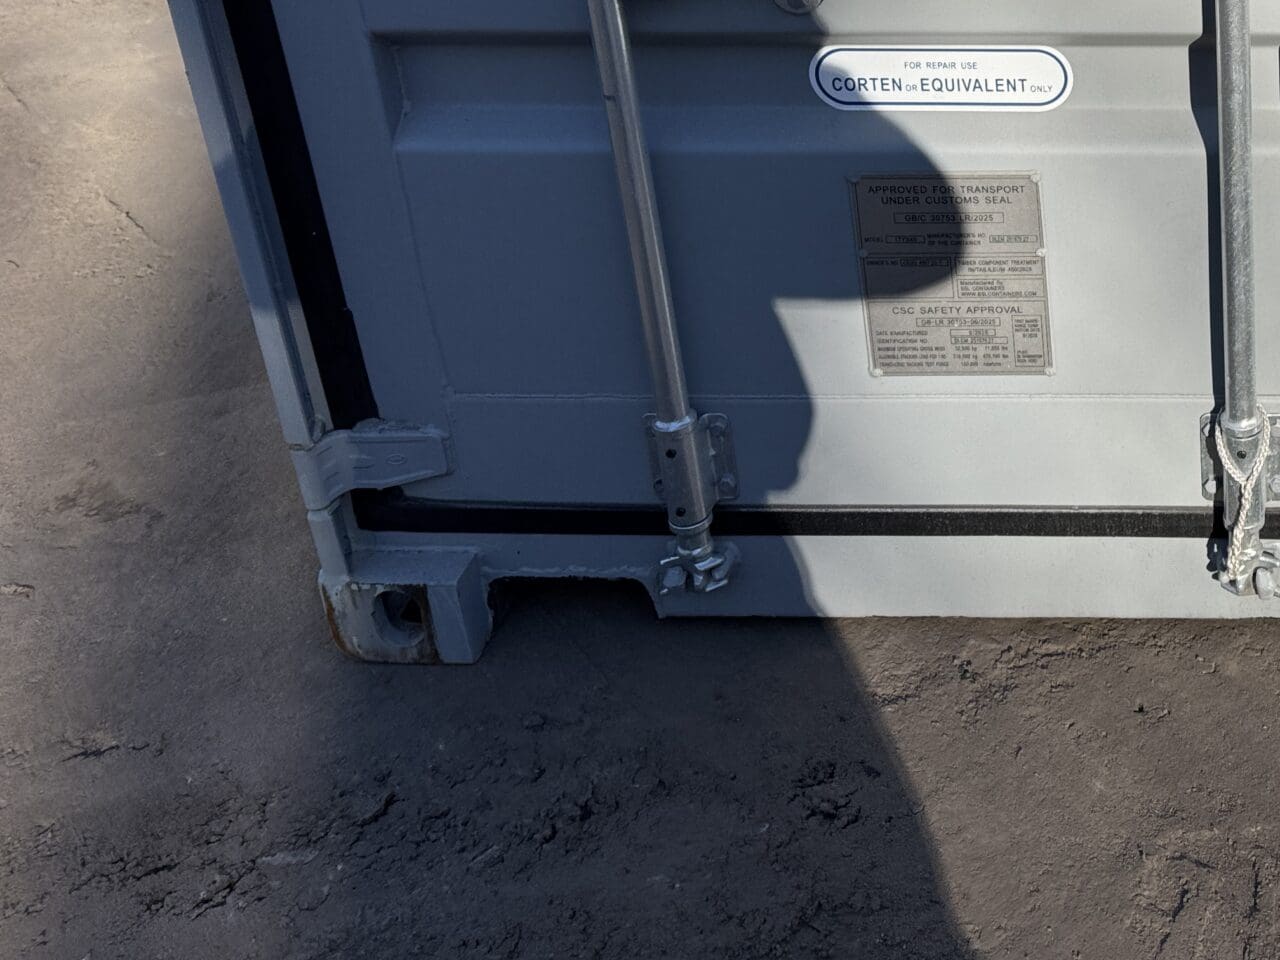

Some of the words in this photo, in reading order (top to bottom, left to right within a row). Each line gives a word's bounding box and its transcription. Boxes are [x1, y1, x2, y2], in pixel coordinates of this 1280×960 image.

[903, 61, 922, 70] FOR
[925, 61, 957, 70] REPAIR
[960, 61, 978, 70] USE
[831, 76, 902, 92] CORTEN
[905, 84, 918, 92] OR
[920, 77, 1028, 93] EQUIVALENT
[1030, 84, 1053, 93] ONLY
[867, 185, 928, 195] APPROVED
[932, 185, 955, 194] FOR
[959, 185, 1026, 194] TRANSPORT
[880, 196, 920, 205] UNDER
[924, 196, 980, 205] CUSTOMS
[984, 196, 1013, 205] SEAL
[891, 306, 915, 315] CSC
[919, 306, 961, 315] SAFETY
[966, 306, 1024, 314] APPROVAL
